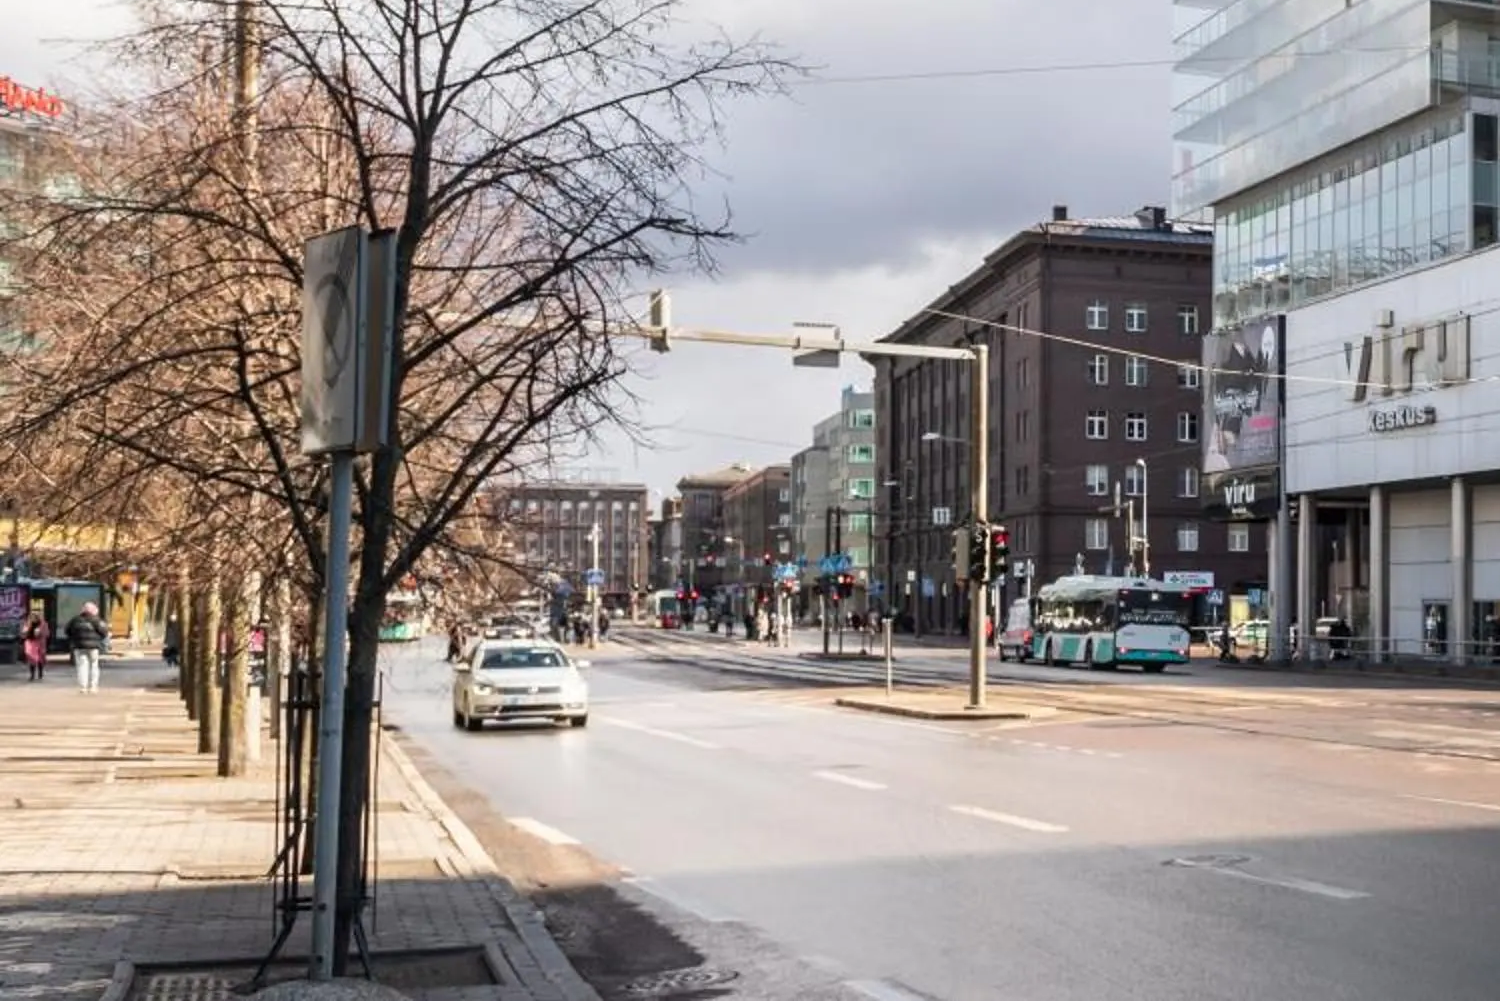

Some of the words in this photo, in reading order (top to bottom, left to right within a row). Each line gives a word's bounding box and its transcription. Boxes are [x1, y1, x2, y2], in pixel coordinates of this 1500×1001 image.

[1343, 310, 1471, 401] viru
[1368, 407, 1430, 432] keskus
[1224, 479, 1256, 504] viru
